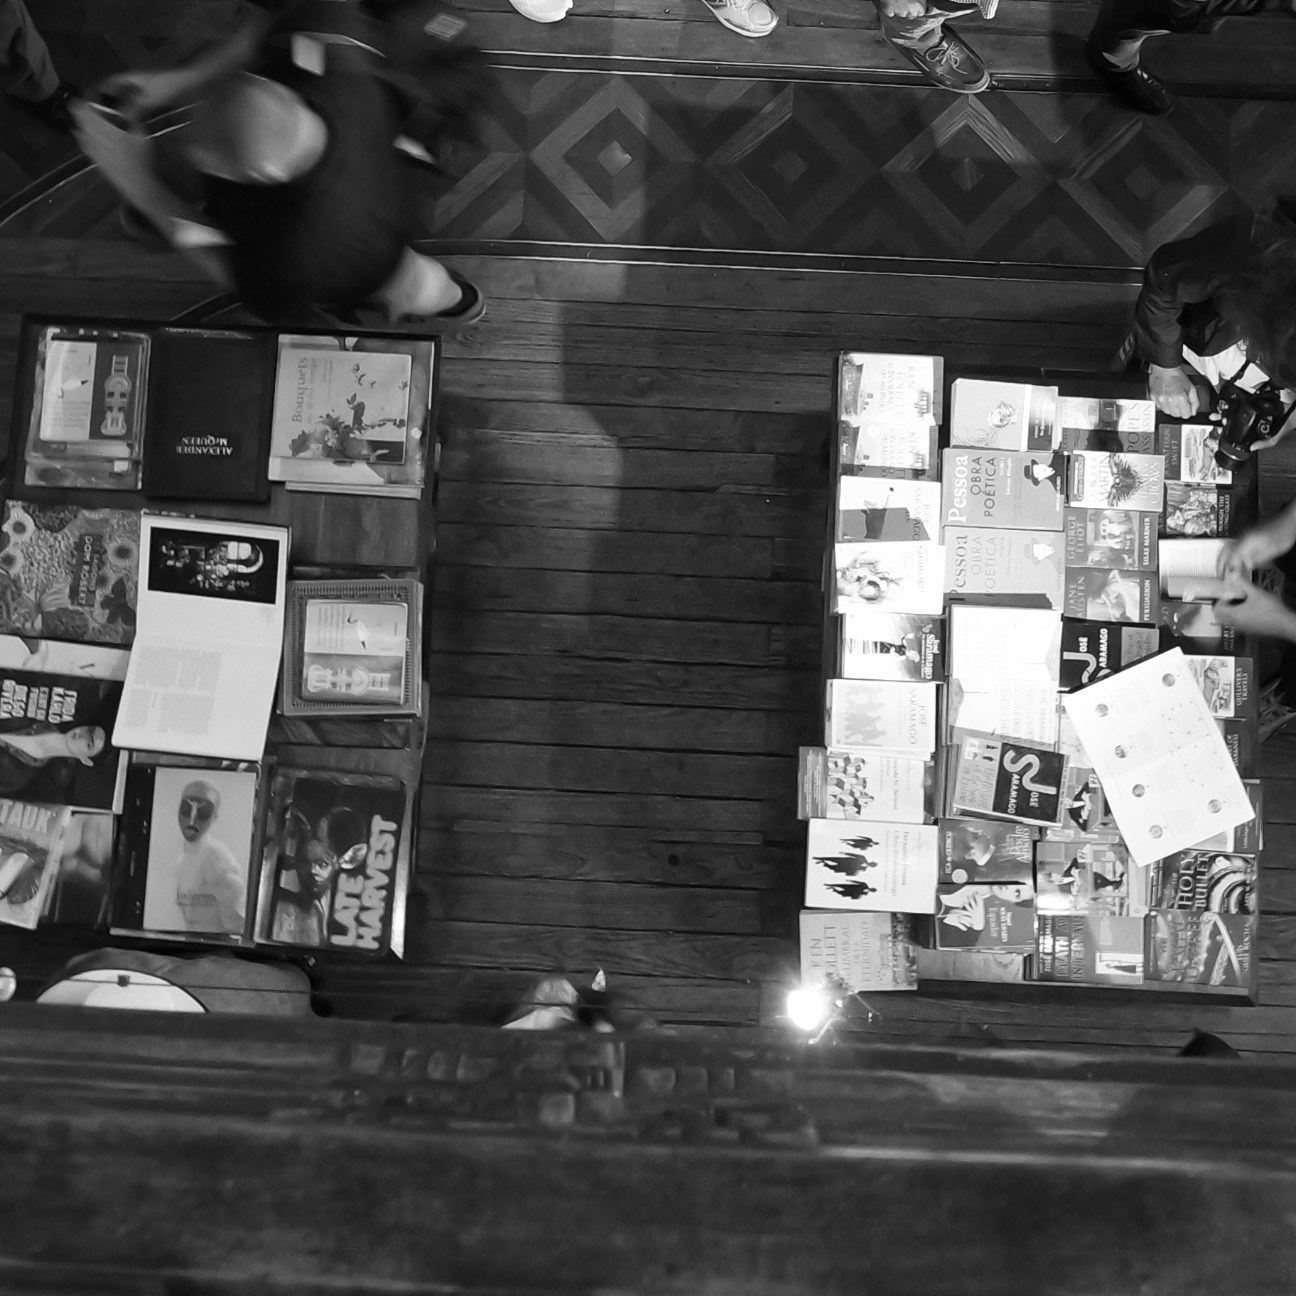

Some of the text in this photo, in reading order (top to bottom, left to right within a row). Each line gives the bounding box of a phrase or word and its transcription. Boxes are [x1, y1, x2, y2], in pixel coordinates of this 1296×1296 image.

[291, 356, 309, 423] Bouquets
[1169, 439, 1180, 465] SWIFT
[947, 454, 969, 524] Pessoa
[970, 455, 984, 497] OBRA
[980, 456, 998, 518] POÉTICA
[1066, 515, 1078, 560] GEORGE
[1075, 522, 1086, 553] ELIOT
[1141, 516, 1151, 546] MARNER
[947, 535, 969, 602] Pessoa
[969, 535, 984, 576] OBRA
[1067, 583, 1078, 610] JANE
[1075, 575, 1087, 618] AUSTEN
[1141, 578, 1153, 621] PERSUASION
[1241, 672, 1249, 701] TRAVELS
[354, 814, 399, 950] HARVEST
[1177, 857, 1196, 905] HOLY
[329, 871, 365, 947] LATE
[809, 937, 823, 968] KEN
[1054, 935, 1070, 977] DEATH
